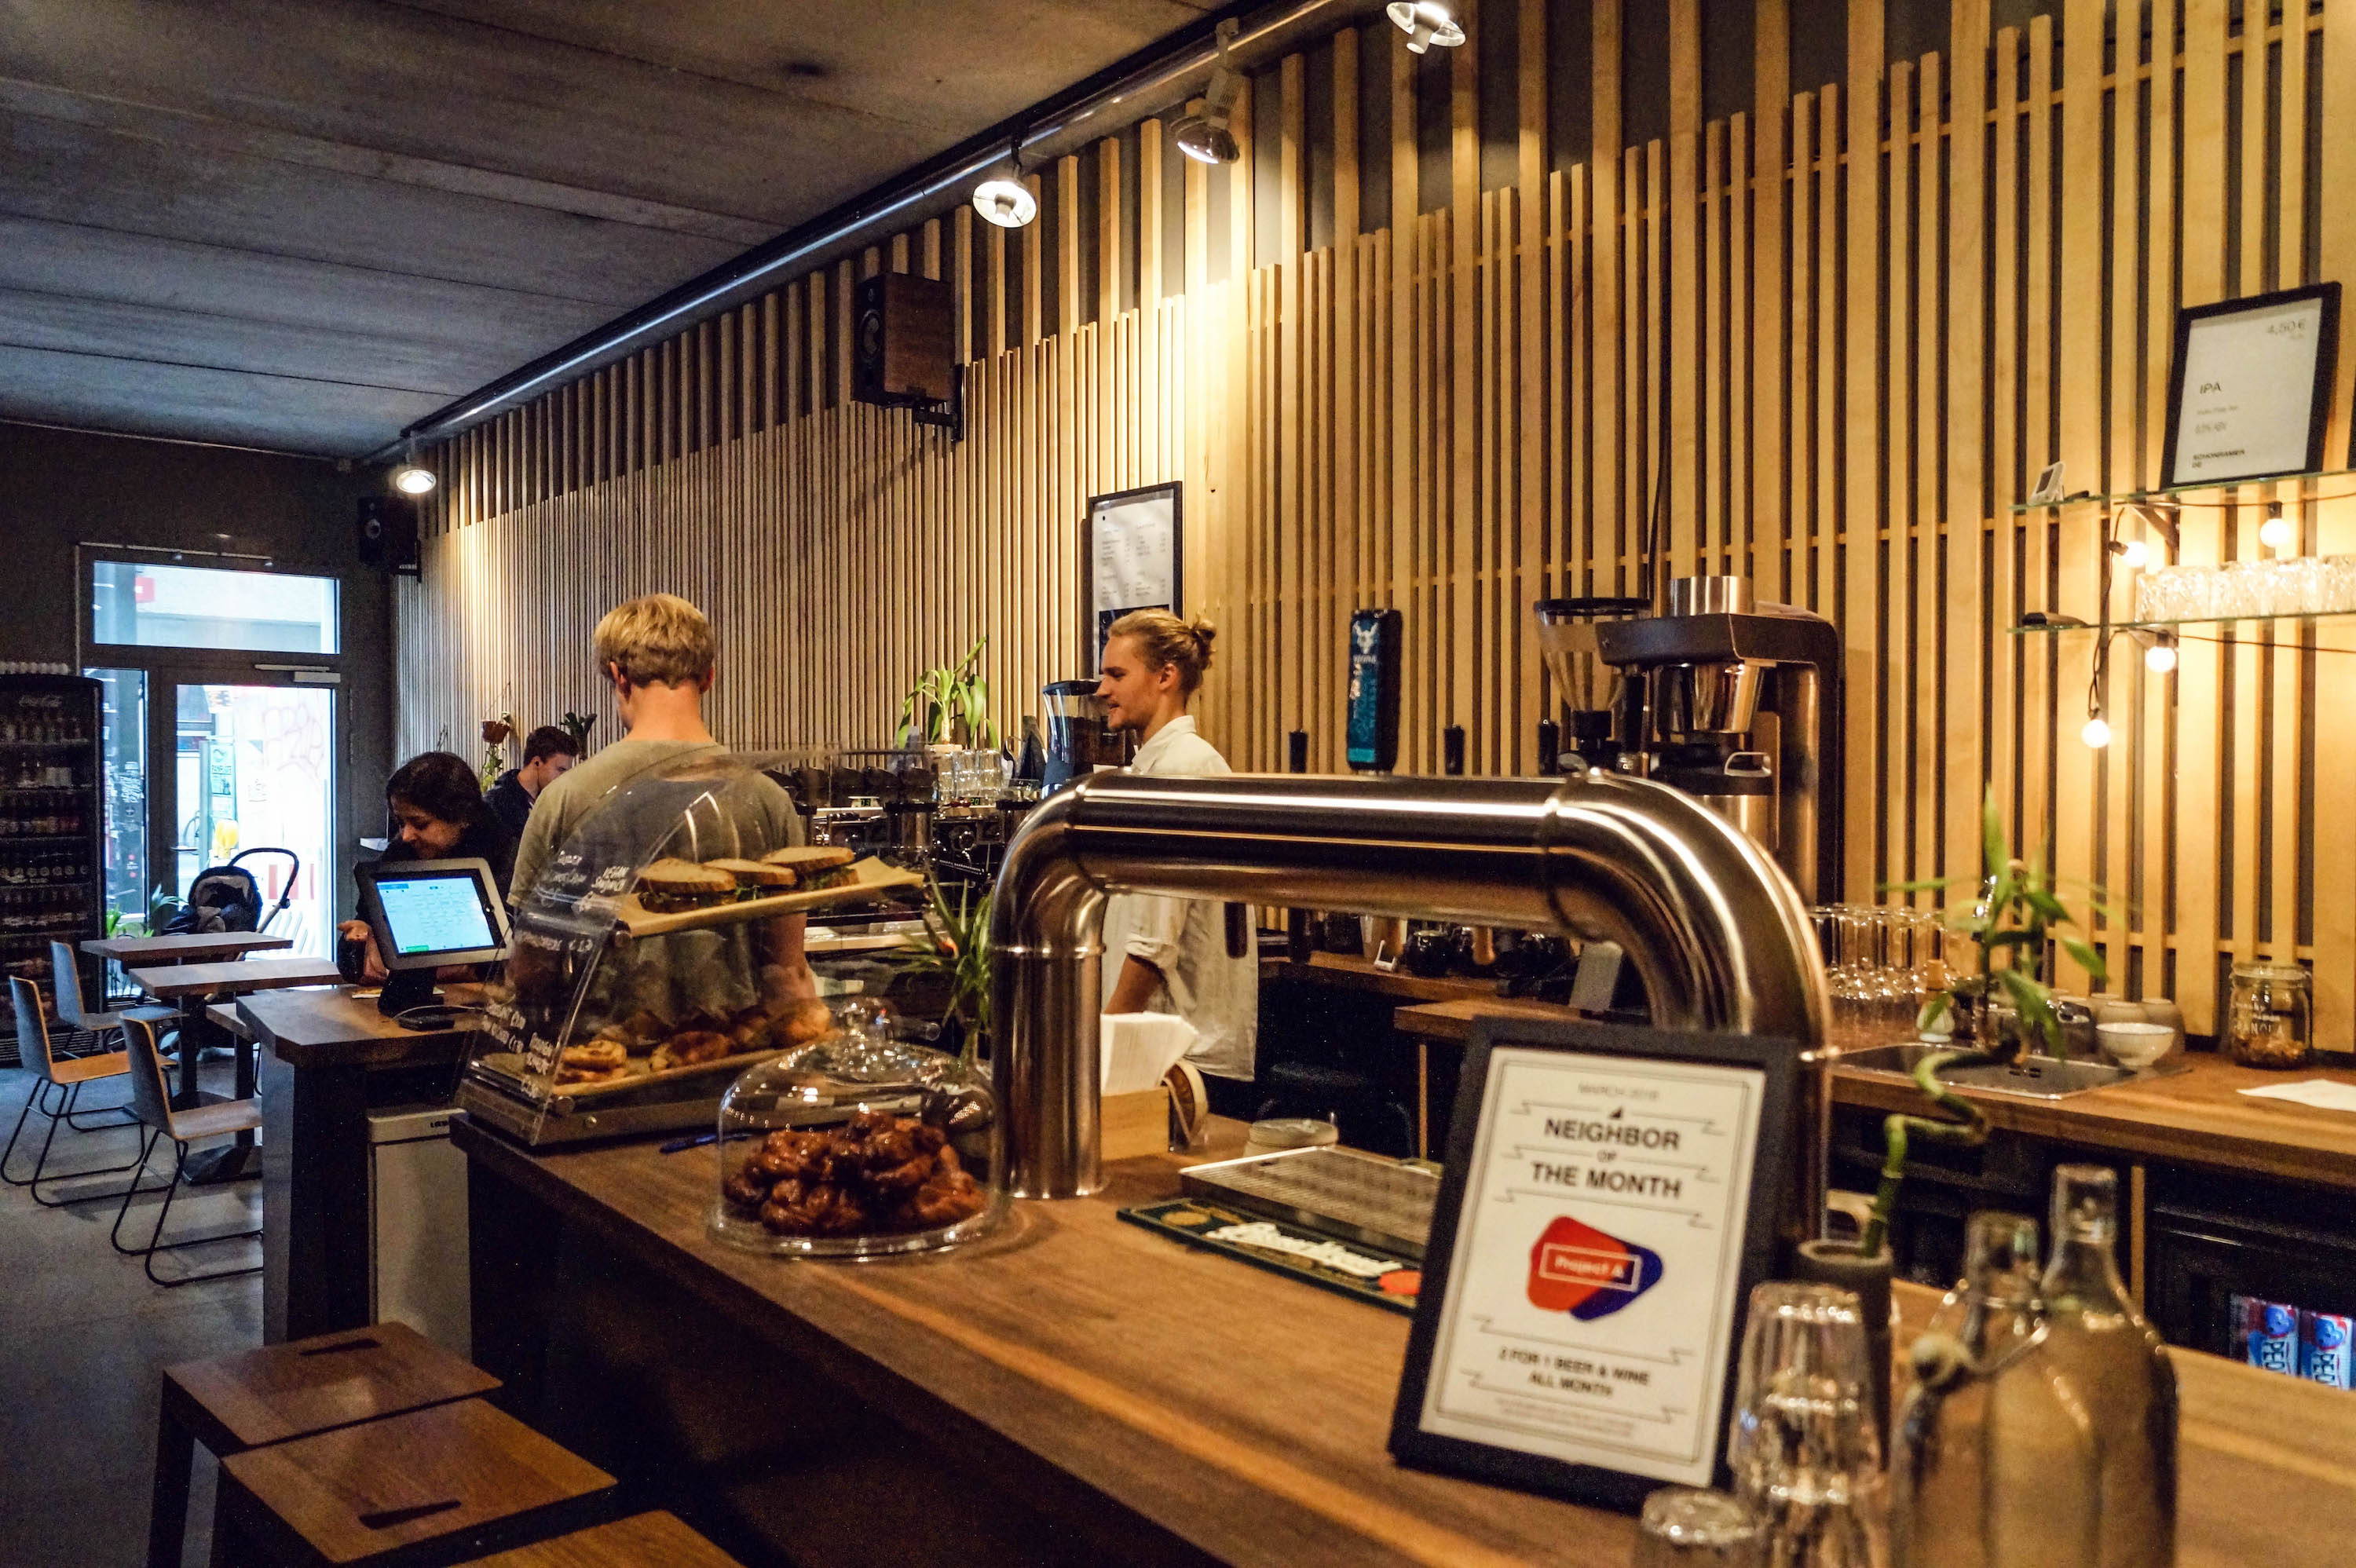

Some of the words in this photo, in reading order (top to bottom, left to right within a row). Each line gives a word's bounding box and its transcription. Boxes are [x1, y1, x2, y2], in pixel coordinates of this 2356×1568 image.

[2200, 382, 2222, 394] IPA
[1545, 1118, 1680, 1149] NEIGHBOR
[1597, 1149, 1618, 1164] OF
[1532, 1161, 1579, 1187] THE
[1586, 1168, 1682, 1200] MONTH
[1612, 1264, 1625, 1278] A
[1511, 1350, 1539, 1364] FOR
[1612, 1367, 1650, 1385] WINE
[1528, 1371, 1554, 1388] ALL
